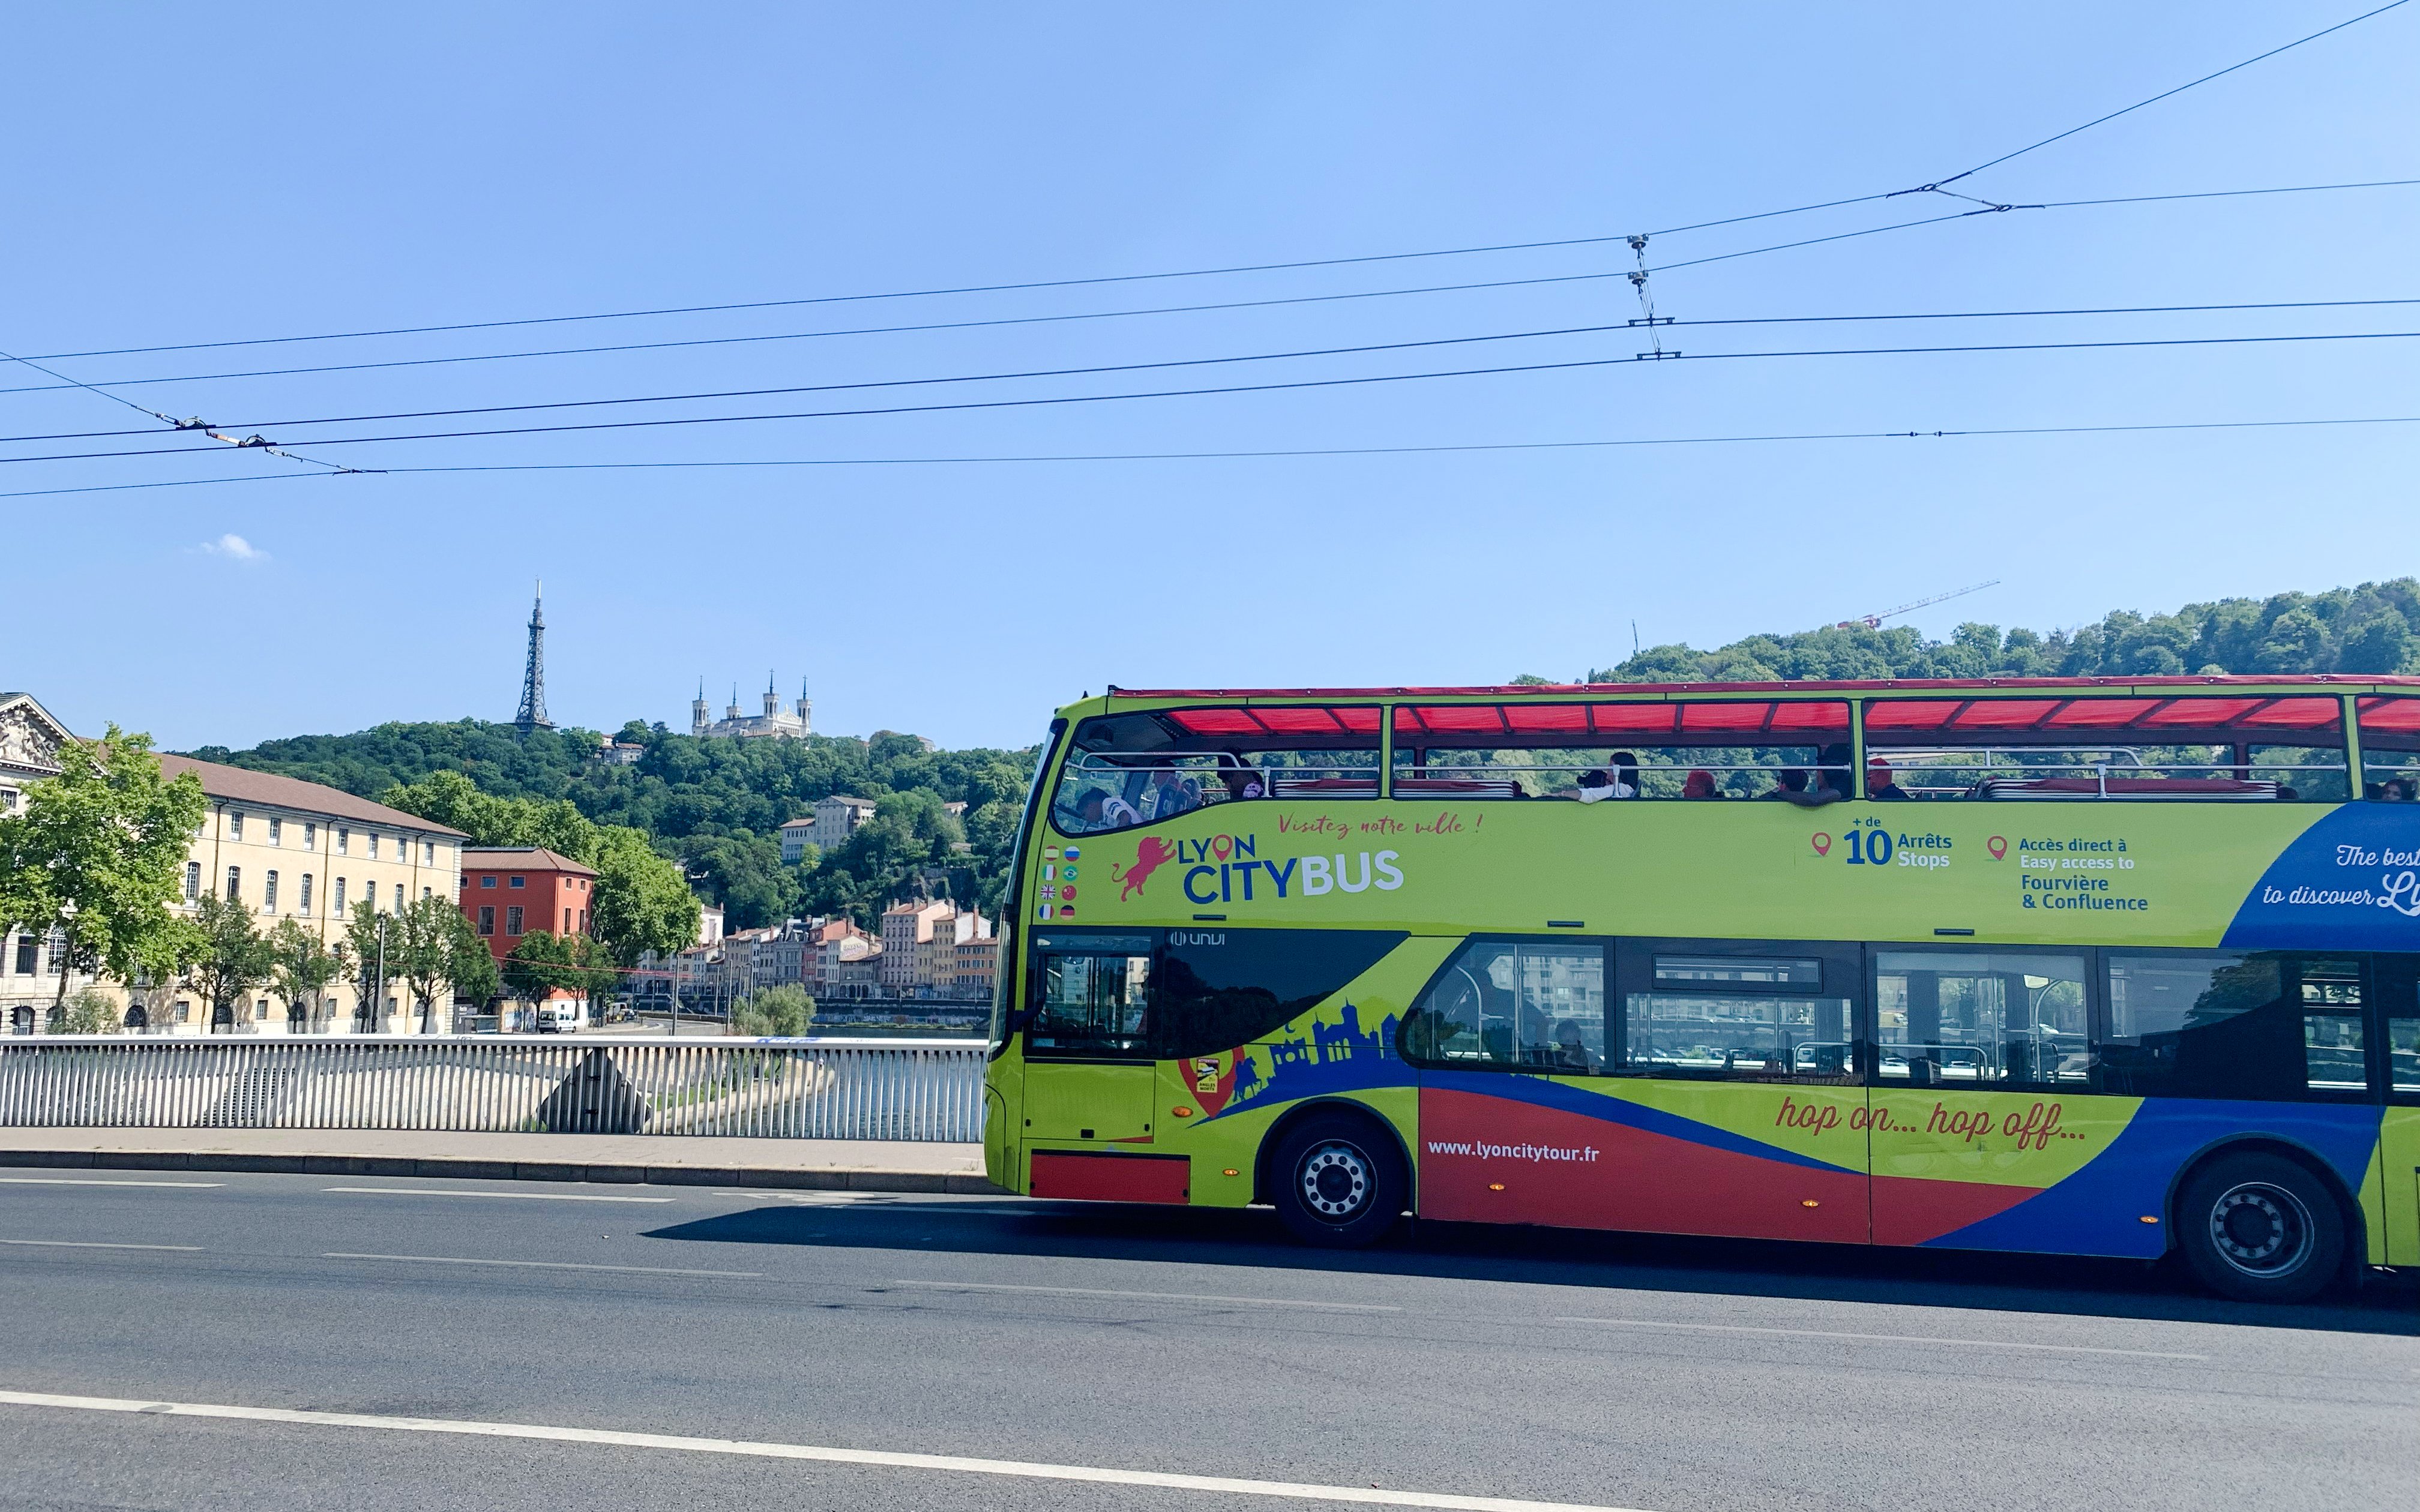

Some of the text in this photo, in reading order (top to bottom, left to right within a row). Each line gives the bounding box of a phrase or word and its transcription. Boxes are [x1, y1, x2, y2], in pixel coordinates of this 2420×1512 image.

[1279, 812, 1352, 840] Visitez
[1360, 815, 1407, 835] notre
[1415, 811, 1465, 835] ville
[1865, 817, 1881, 827] de
[1843, 830, 1892, 865] 10
[1897, 833, 1952, 849] Arrêts
[2019, 838, 2127, 852] Accès direct à
[1897, 851, 1950, 871] Stops
[2020, 854, 2134, 872] Easy access to
[2337, 845, 2379, 866] The
[2021, 875, 2109, 891] Fourvière
[2022, 894, 2149, 911] & Confluence
[2263, 885, 2285, 904] to
[2289, 886, 2374, 905] discover
[1775, 1096, 2085, 1151] hop on... hop off...
[1428, 1141, 1600, 1162] www.lyoncitytour.fr
